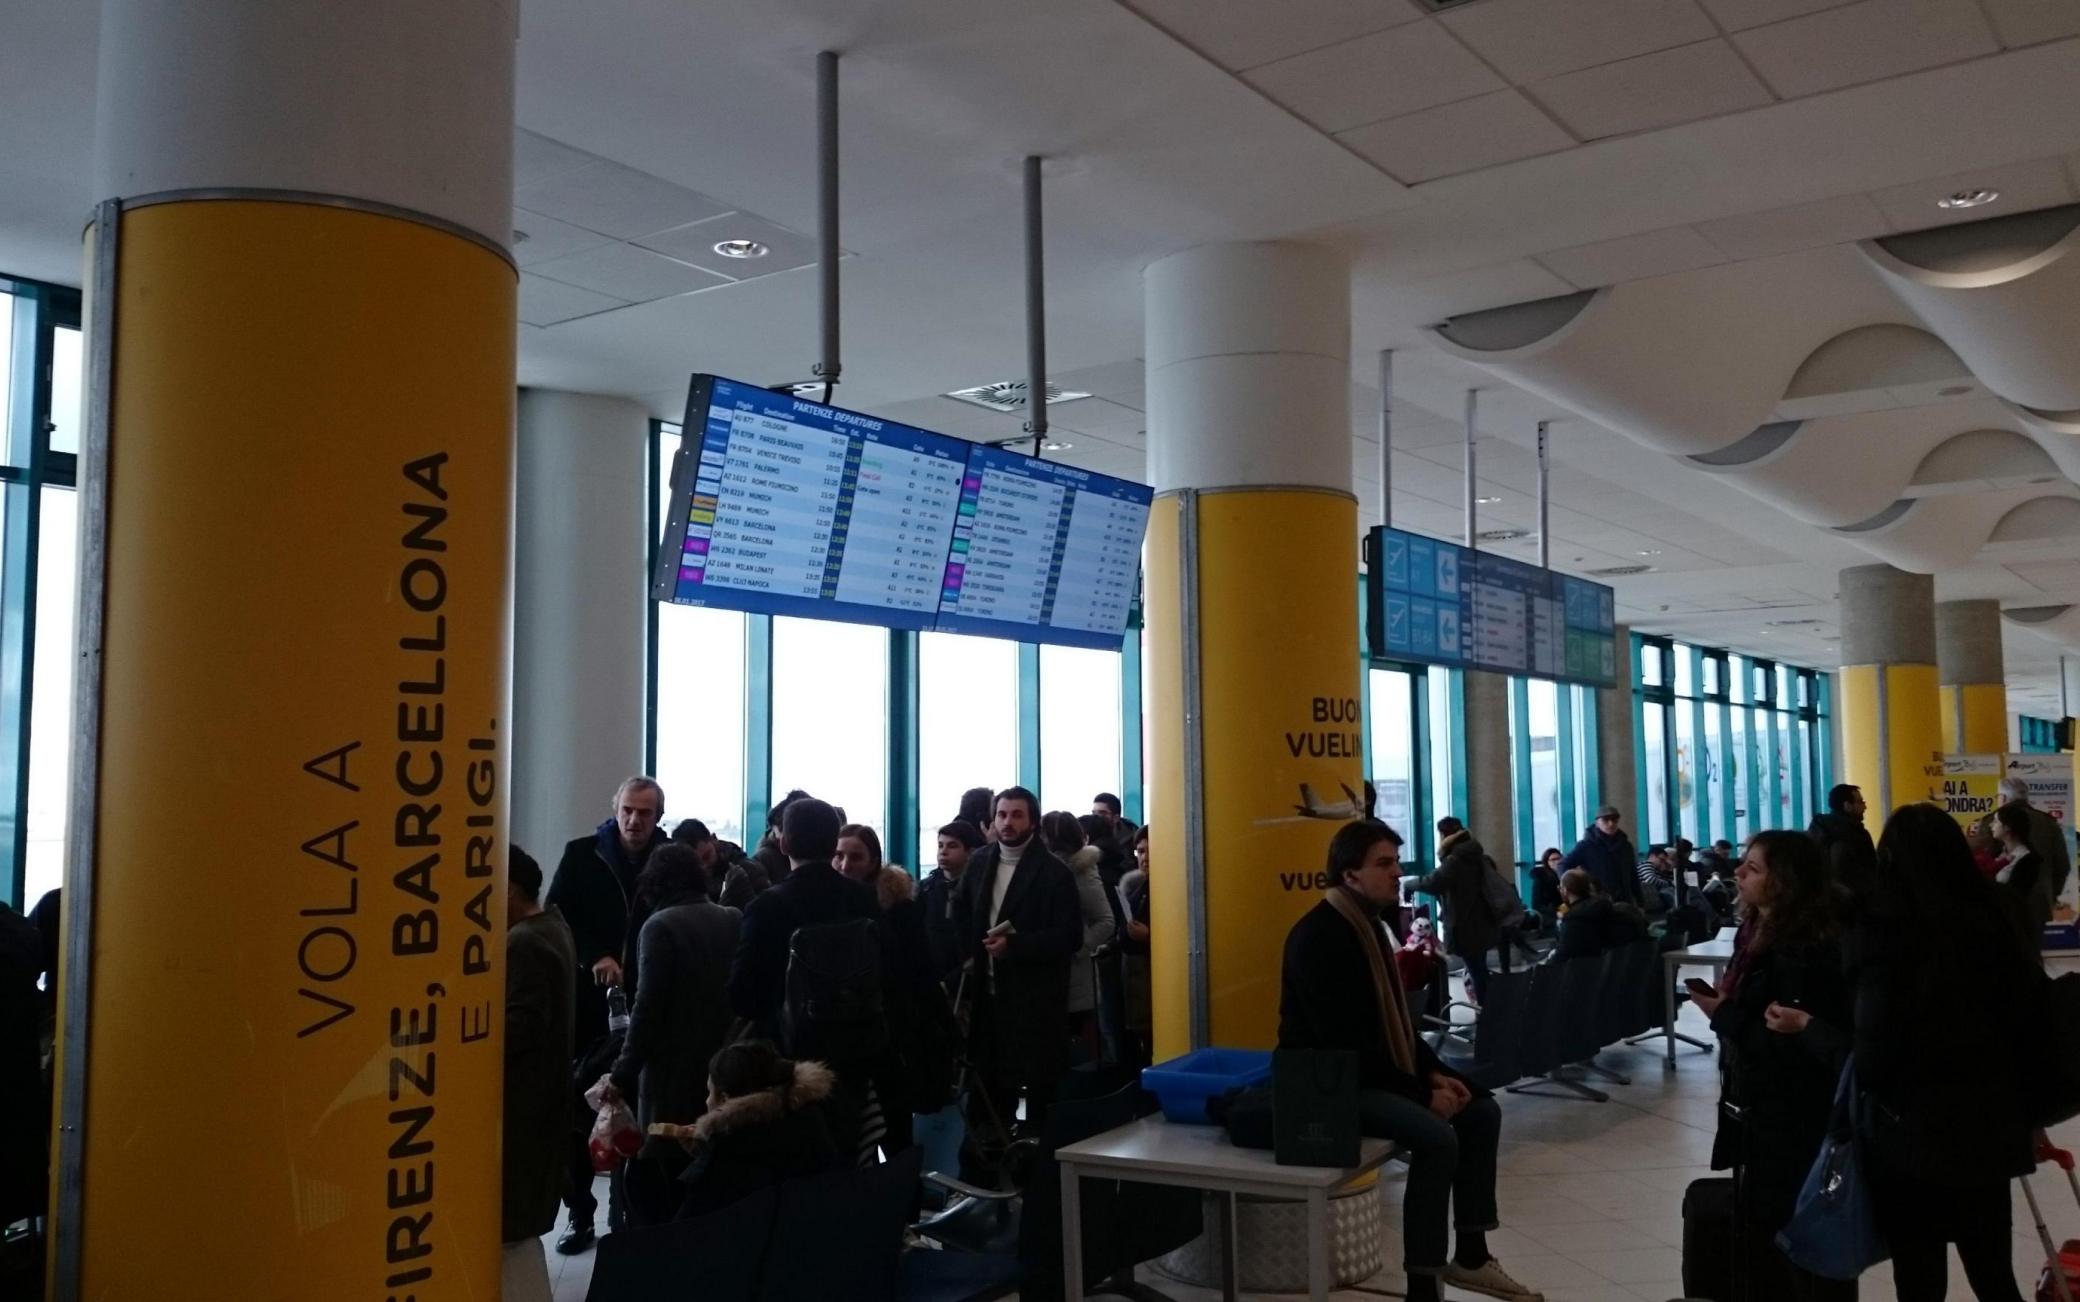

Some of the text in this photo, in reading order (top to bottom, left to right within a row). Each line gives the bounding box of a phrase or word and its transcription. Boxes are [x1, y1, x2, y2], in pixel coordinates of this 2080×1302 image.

[793, 401, 883, 431] PARTENZE DEPARTURES
[754, 463, 780, 475] PALERMO
[744, 521, 776, 532] BARCELONA
[741, 535, 774, 546] BARCELONA
[738, 549, 767, 559] BUDAPEST
[1959, 781, 1968, 794] A
[2029, 783, 2068, 791] TRANSFER
[385, 452, 449, 1302] IRENZE, BARCELLONA
[461, 718, 496, 1043] E PARIGI.
[297, 741, 361, 1038] VOLA A
